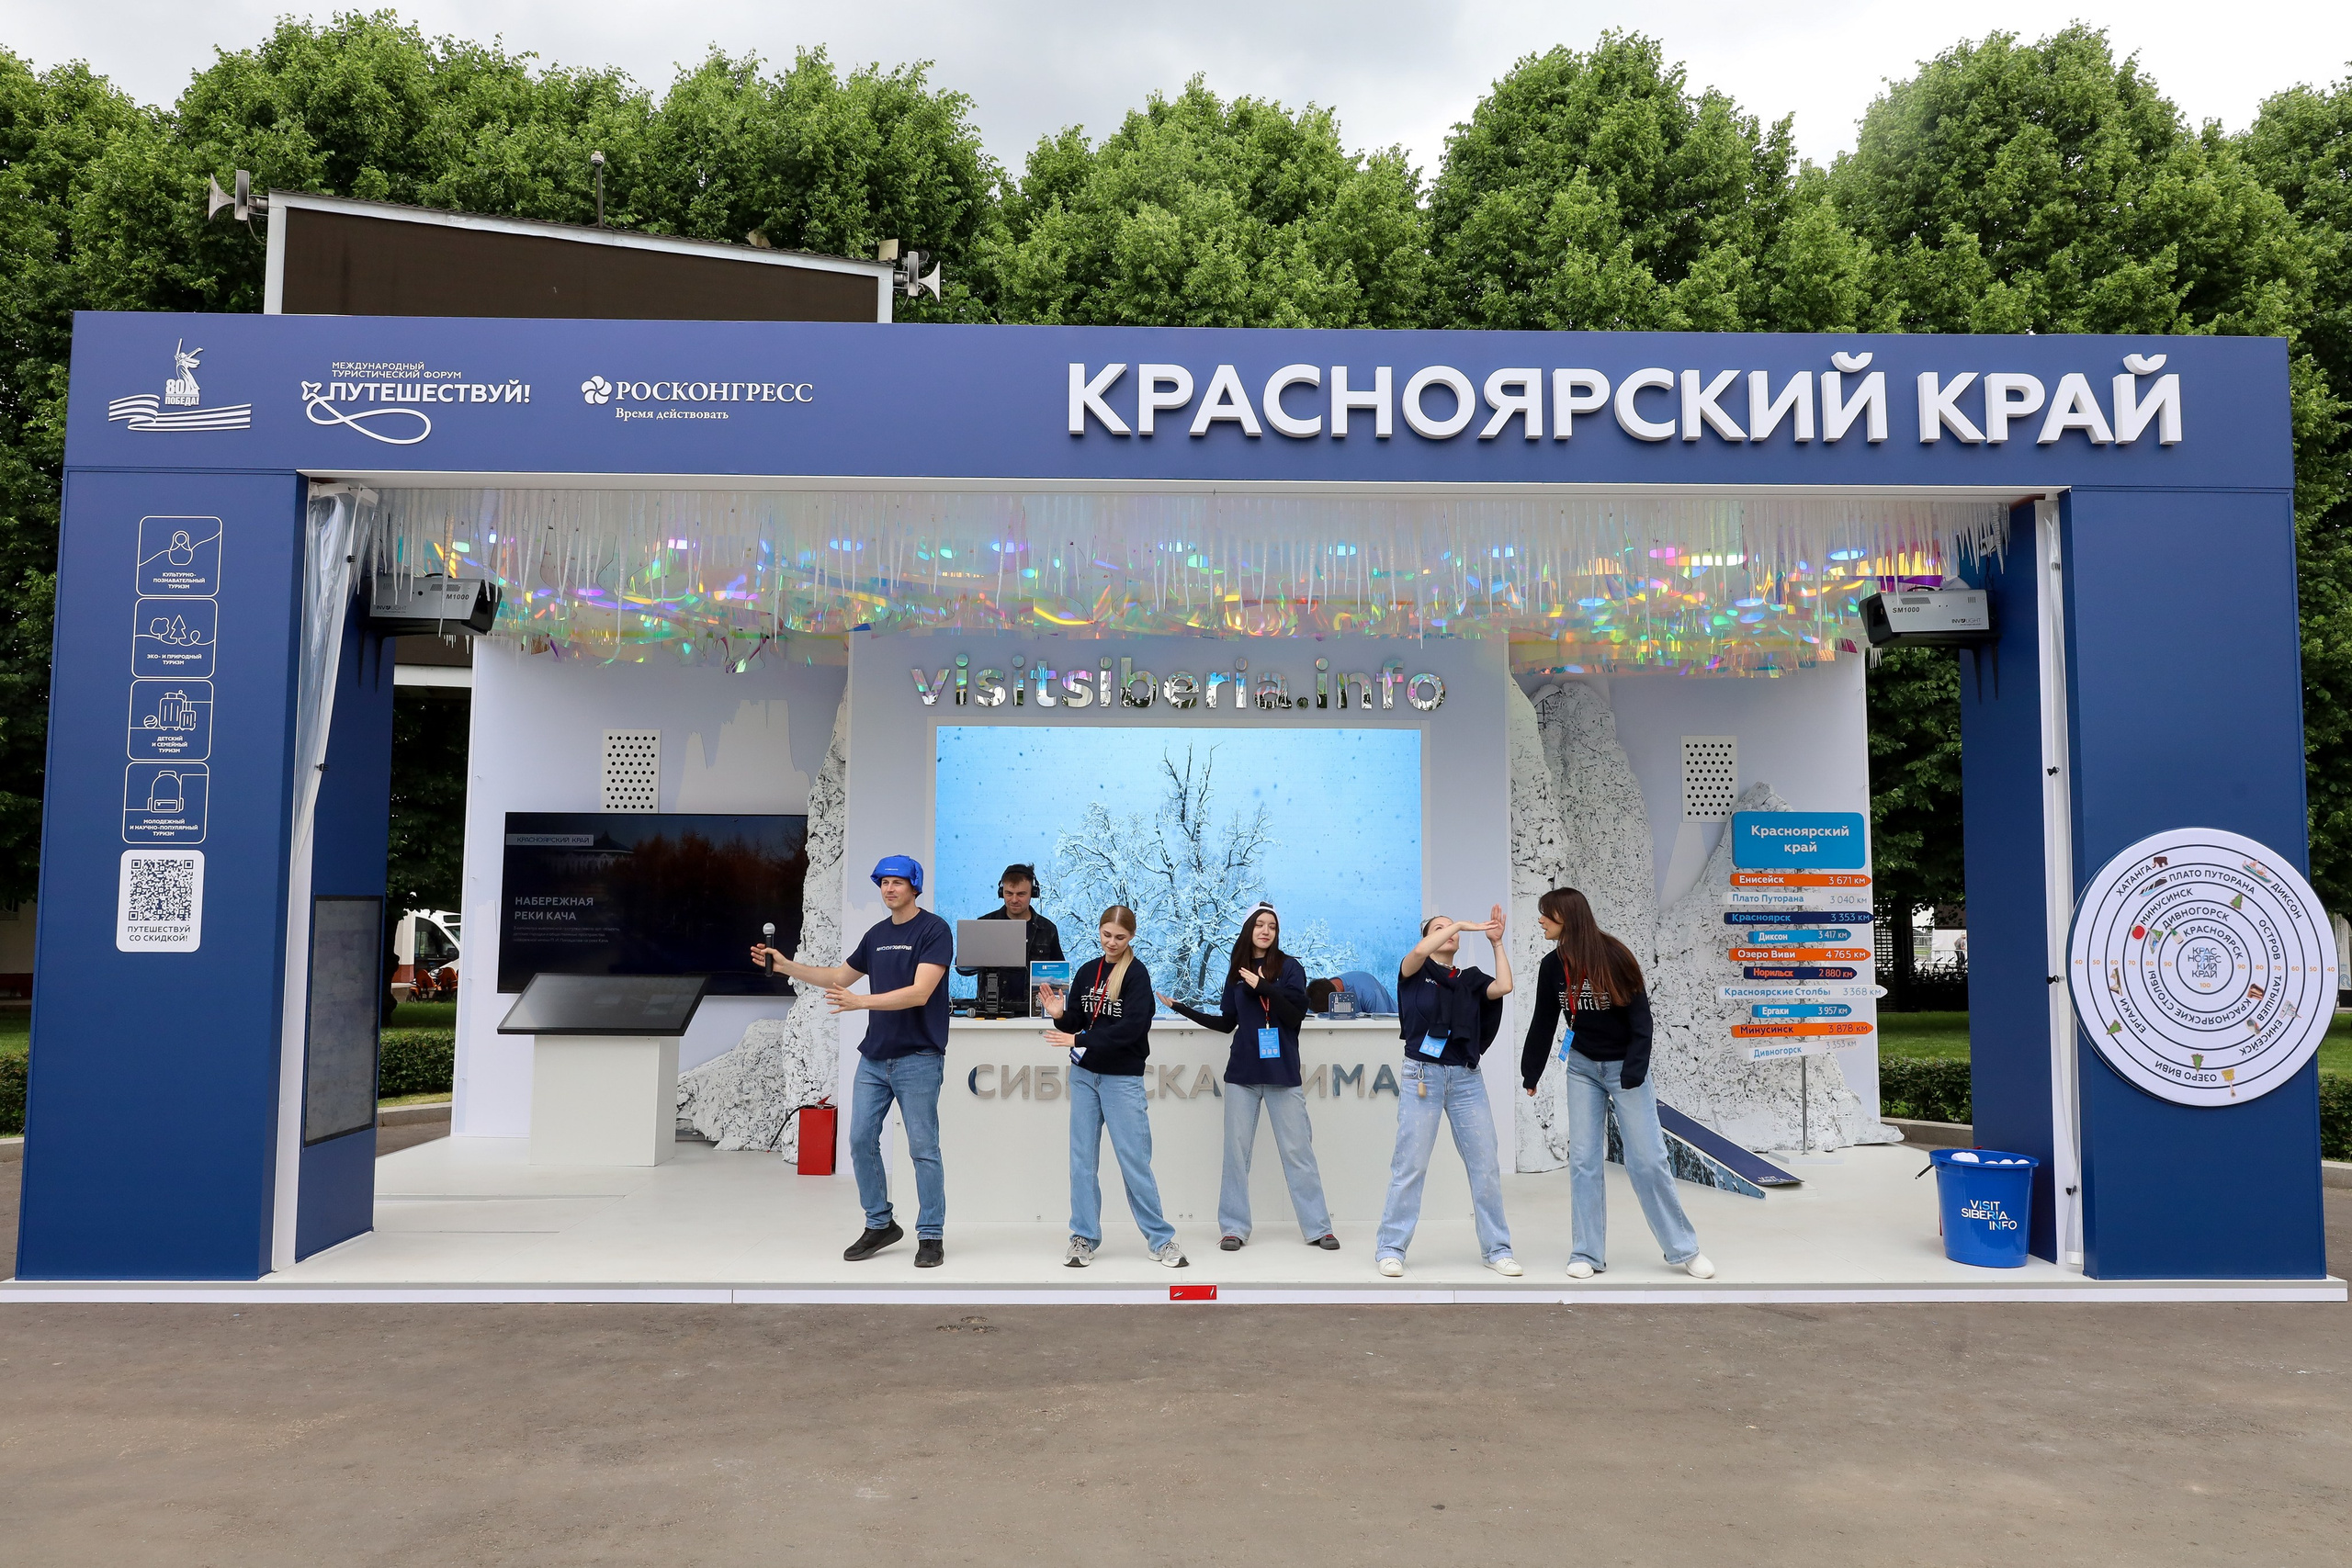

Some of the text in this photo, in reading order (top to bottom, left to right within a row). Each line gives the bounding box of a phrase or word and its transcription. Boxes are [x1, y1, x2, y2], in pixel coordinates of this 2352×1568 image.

[332, 361, 424, 371] МЕЖДУНАРОДНЫЙ
[332, 369, 462, 379] ТУРИСТИЧЕСКИЙ ФОРУМ
[165, 378, 185, 394] 80
[329, 379, 531, 403] ПУТЕШЕСТВУЙ!
[615, 381, 814, 402] РОСКОНГРЕСС
[165, 396, 200, 406] ПОБЕДА!
[1069, 351, 2182, 446] КРАСНОЯРСКИЙ КРАЙ
[615, 408, 729, 422] Время действовать
[910, 653, 1447, 711] visitsiberia.info
[1751, 825, 1849, 839] Красноярский
[1784, 841, 1817, 854] край
[1739, 874, 1784, 884] Енисейск
[2116, 864, 2153, 897] ХАТАНГА
[2168, 869, 2256, 895] ПЛАТО ПУТОРАНА
[514, 897, 594, 906] НАБЕРЕЖНАЯ
[1732, 894, 1759, 902] Плато
[1761, 895, 1804, 904] Путорана
[2270, 883, 2302, 919] ДИКСОН
[2140, 887, 2194, 926] МИНУСИНСК
[514, 911, 577, 920] РЕКИ КАЧА
[1732, 913, 1792, 923] Красноярск
[2162, 907, 2230, 931] ДИВНОГОРСК
[143, 933, 188, 942] СКИДКОЙ!
[1758, 932, 1788, 942] Диксон
[2183, 925, 2244, 960] КРАСНОЯРСК
[1737, 950, 1769, 960] Озеро
[2192, 947, 2217, 955] КРАС
[2188, 954, 2222, 963] НОЯРС
[1753, 967, 1794, 977] Норильск
[2192, 970, 2217, 978] КРАЙ
[2256, 919, 2282, 1021] ОСТРОВ ТАТЫШЕВ
[1724, 987, 1793, 998] Красноярские
[1795, 987, 1831, 996] Столбы
[2148, 970, 2252, 1025] КРАСНОЯРСКИЕ СТОЛБЫ
[1762, 1007, 1789, 1016] Ергаки
[2120, 998, 2147, 1033] ЕРГАКИ
[1740, 1026, 1794, 1035] Минусинск
[2239, 1019, 2283, 1056] ЕНИСЕЙСК
[1754, 1046, 1802, 1058] Дивногорск
[2154, 1060, 2217, 1082] ОЗЕРО ВИВИ
[967, 1063, 1400, 1100] СИБКА ИМА
[1970, 1199, 2000, 1211] VISIT
[1989, 1220, 2018, 1230] INFO
